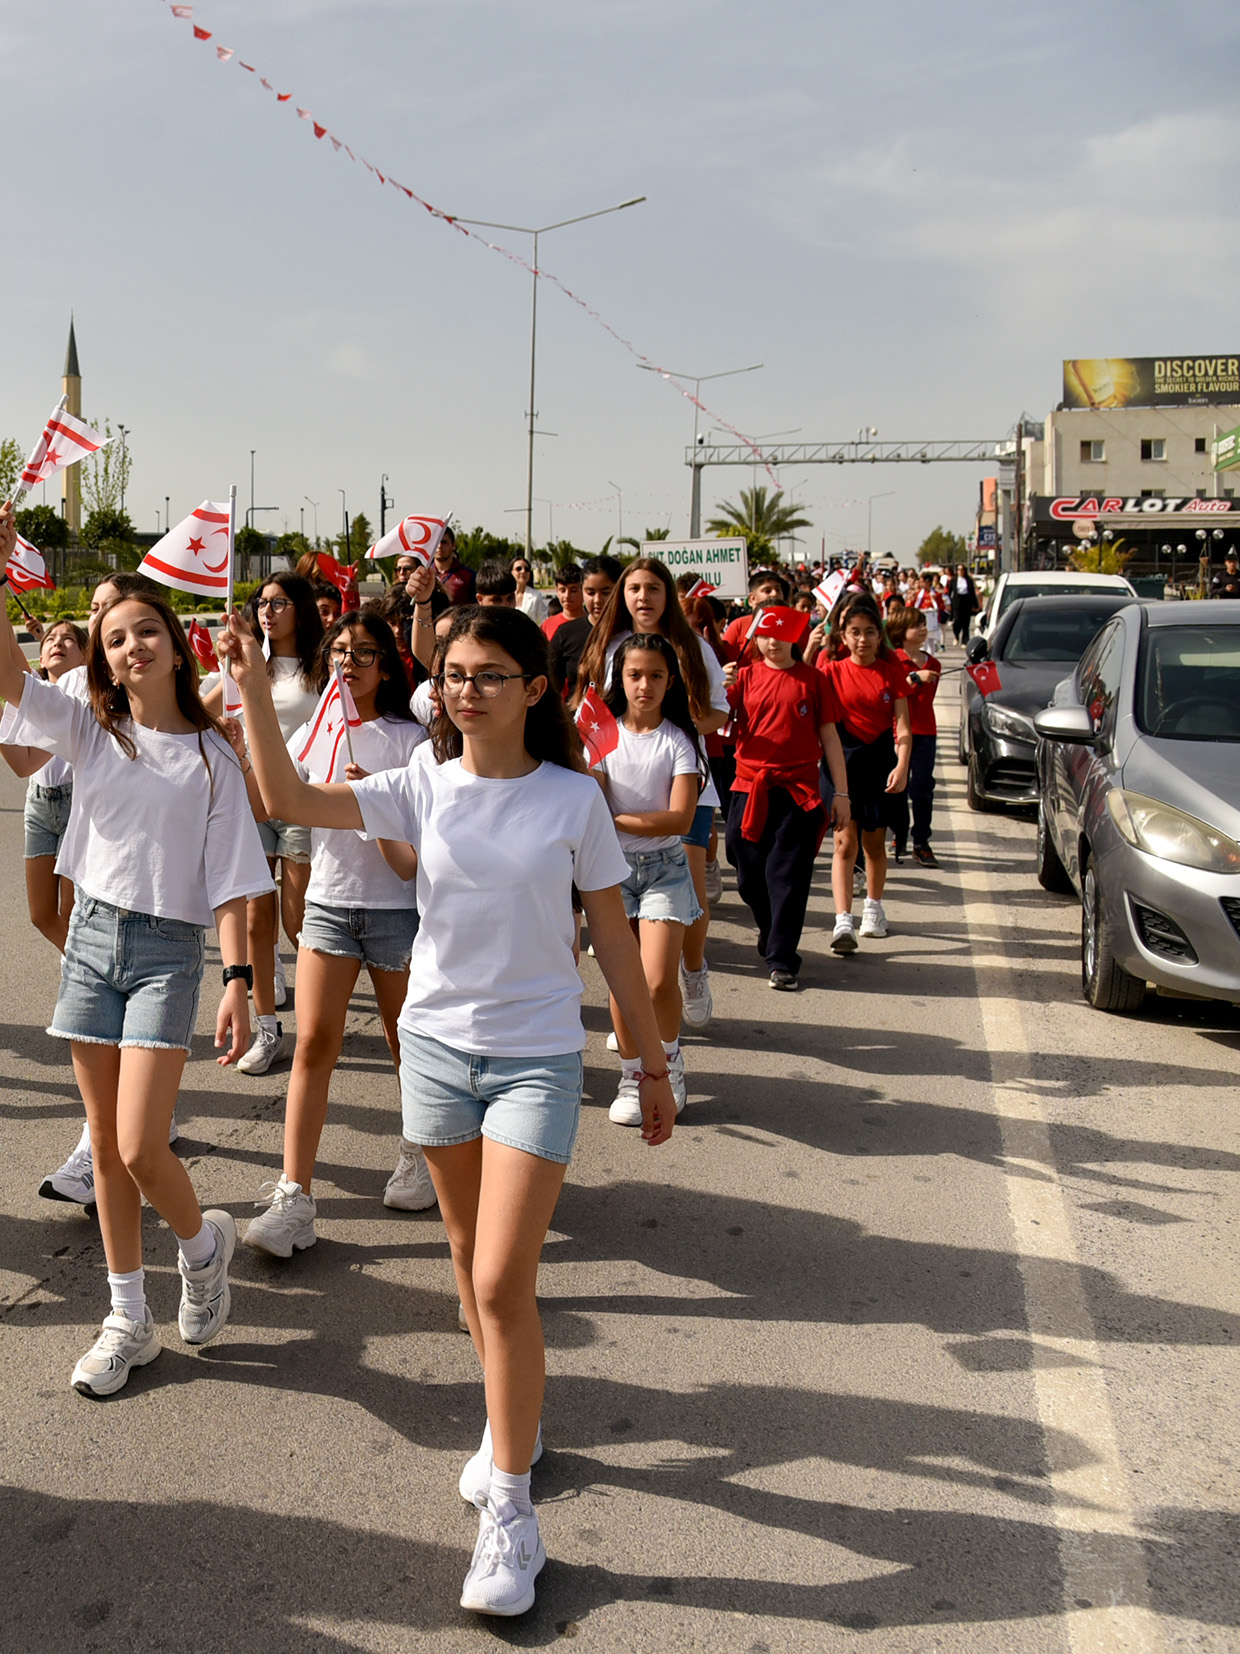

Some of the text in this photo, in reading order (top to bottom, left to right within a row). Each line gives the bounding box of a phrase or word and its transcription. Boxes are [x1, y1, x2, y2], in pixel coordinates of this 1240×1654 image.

[1154, 359, 1239, 377] DISCOVER
[1155, 382, 1240, 393] SMOKIER FLAVOUR
[1049, 498, 1232, 521] CARLOT Auto
[668, 547, 703, 565] DOĞAN
[706, 548, 741, 563] AHMET
